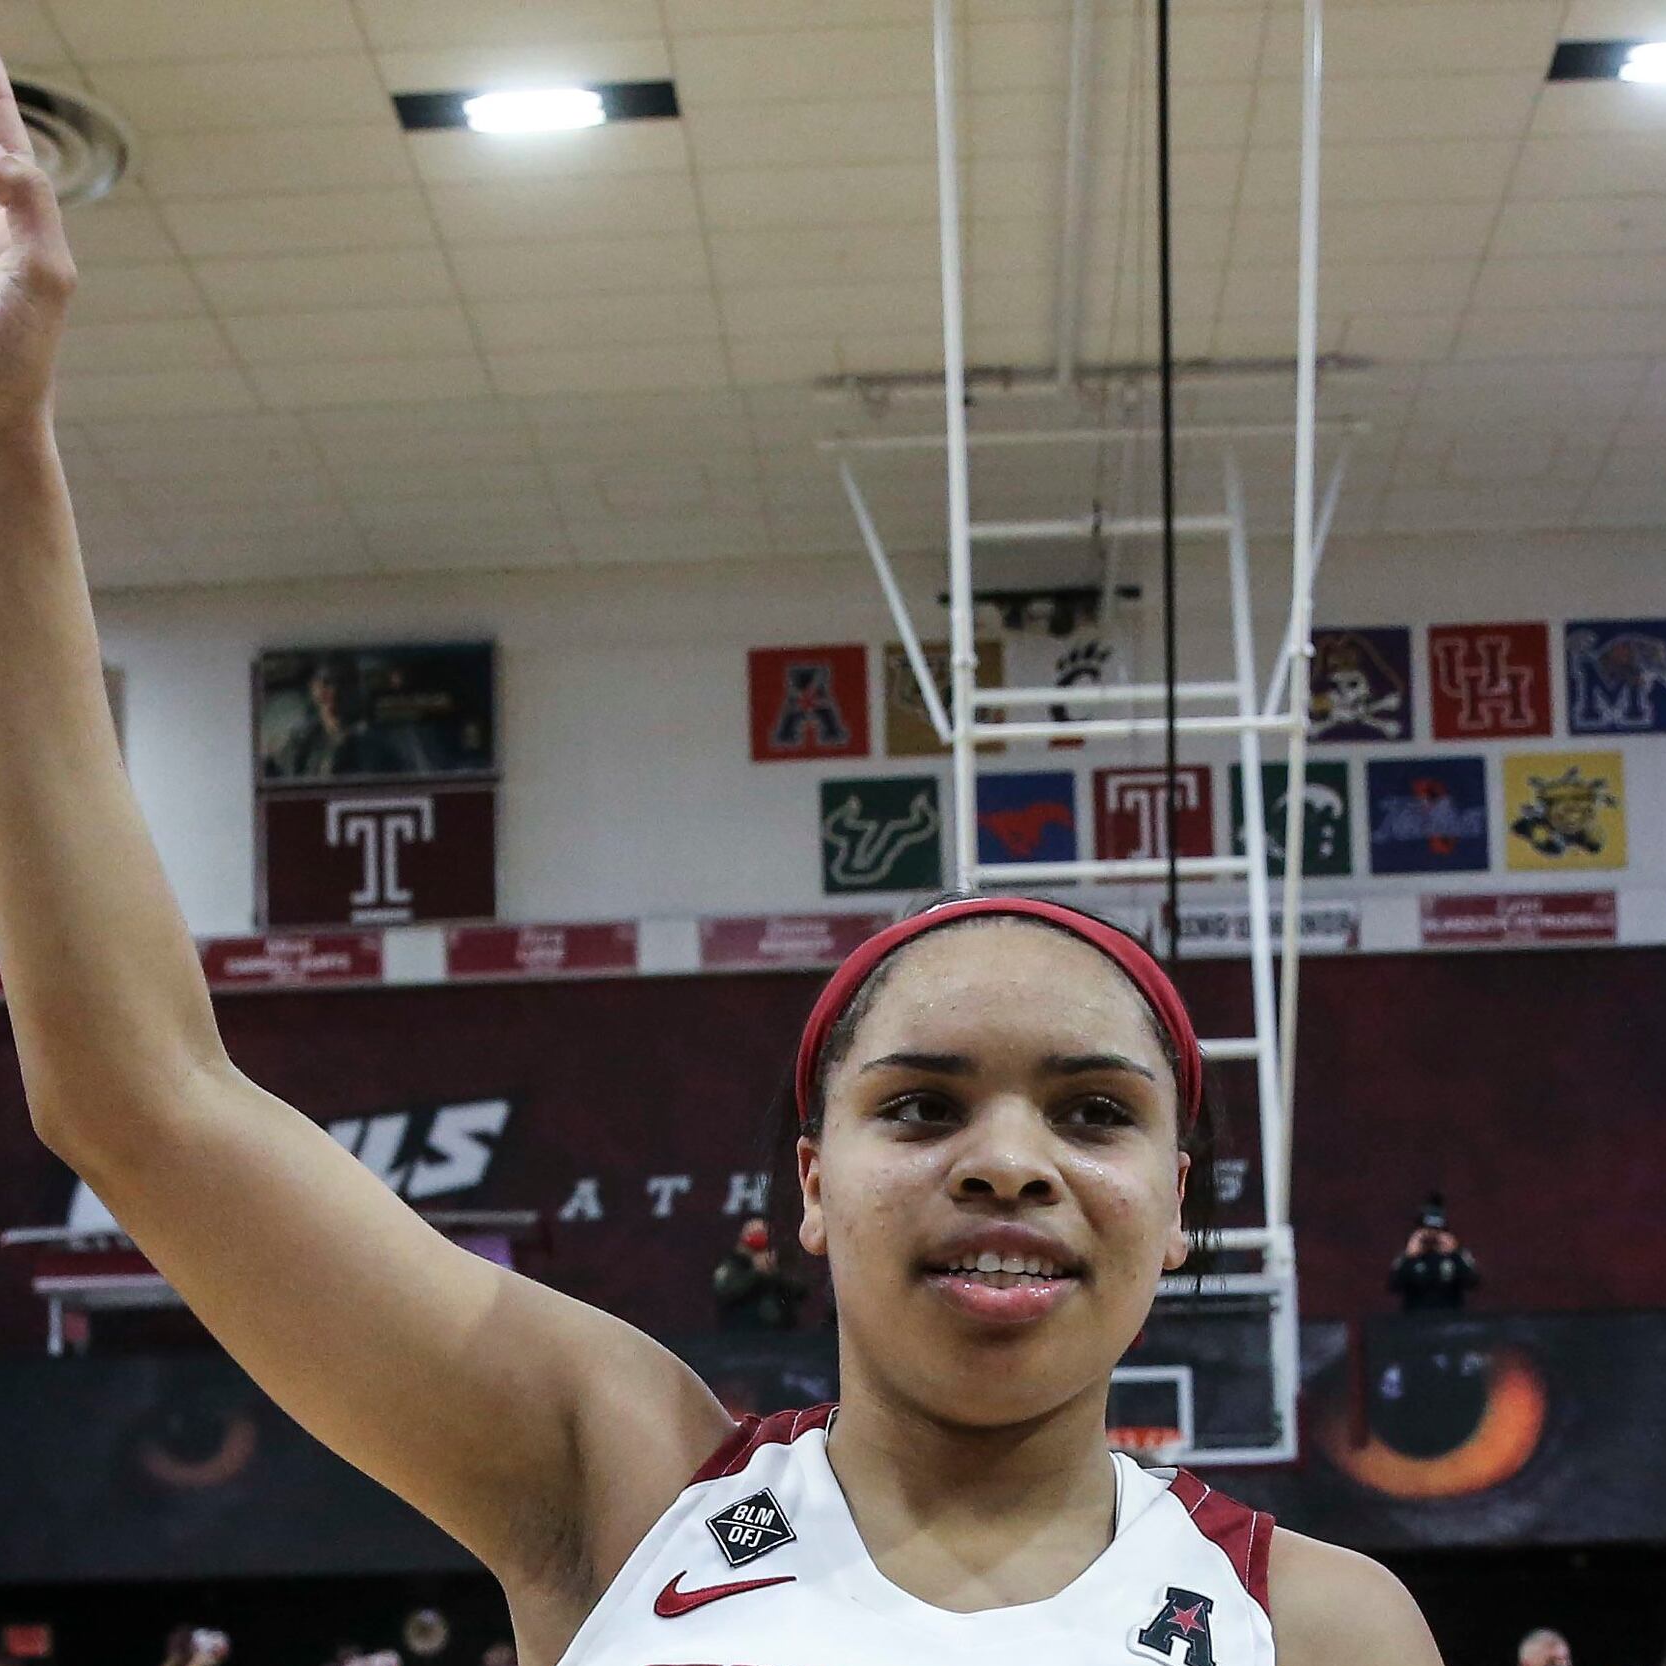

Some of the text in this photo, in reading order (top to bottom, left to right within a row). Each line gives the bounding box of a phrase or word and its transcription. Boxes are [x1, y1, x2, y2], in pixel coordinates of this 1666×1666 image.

[325, 796, 433, 925] T
[732, 1504, 775, 1527] BLM
[728, 1526, 763, 1548] OFJ
